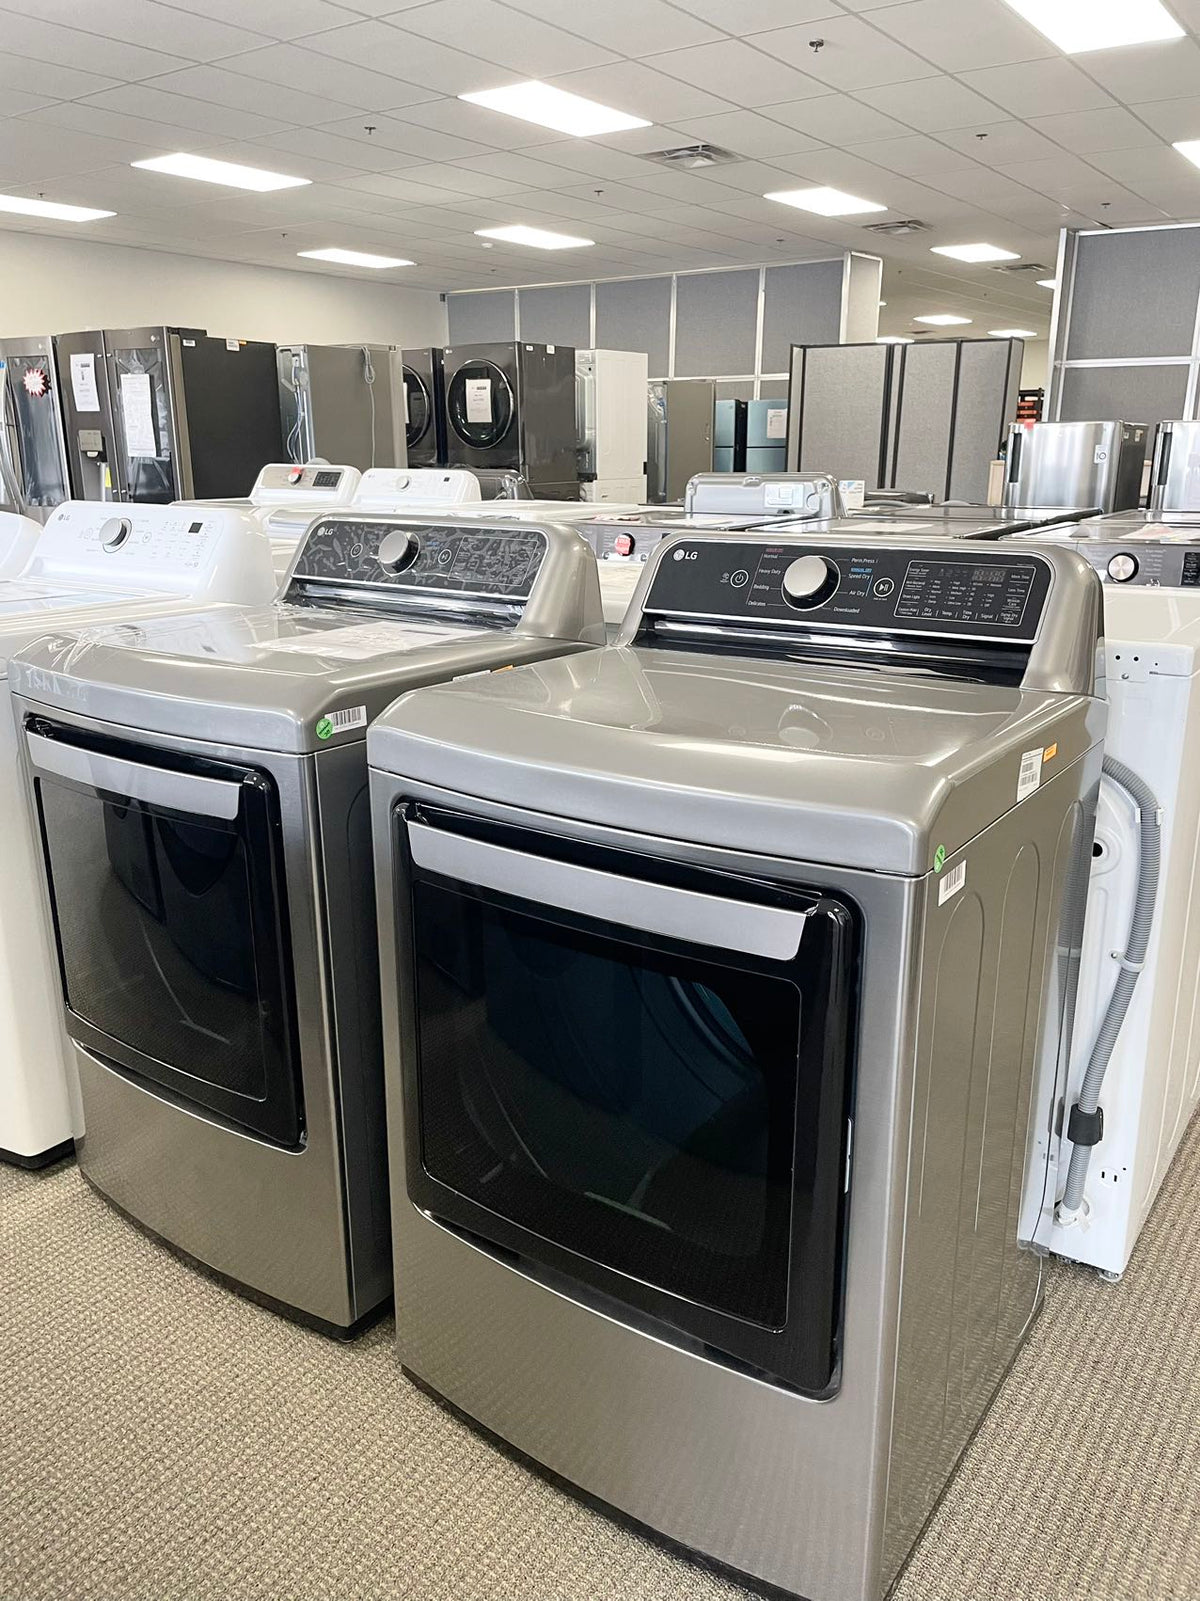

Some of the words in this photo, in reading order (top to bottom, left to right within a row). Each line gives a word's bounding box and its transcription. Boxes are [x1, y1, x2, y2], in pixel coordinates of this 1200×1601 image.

[324, 528, 334, 536] LG
[684, 551, 698, 561] LG
[771, 568, 781, 576] Duty
[862, 573, 871, 581] Dry
[833, 606, 861, 614] Downloaded
